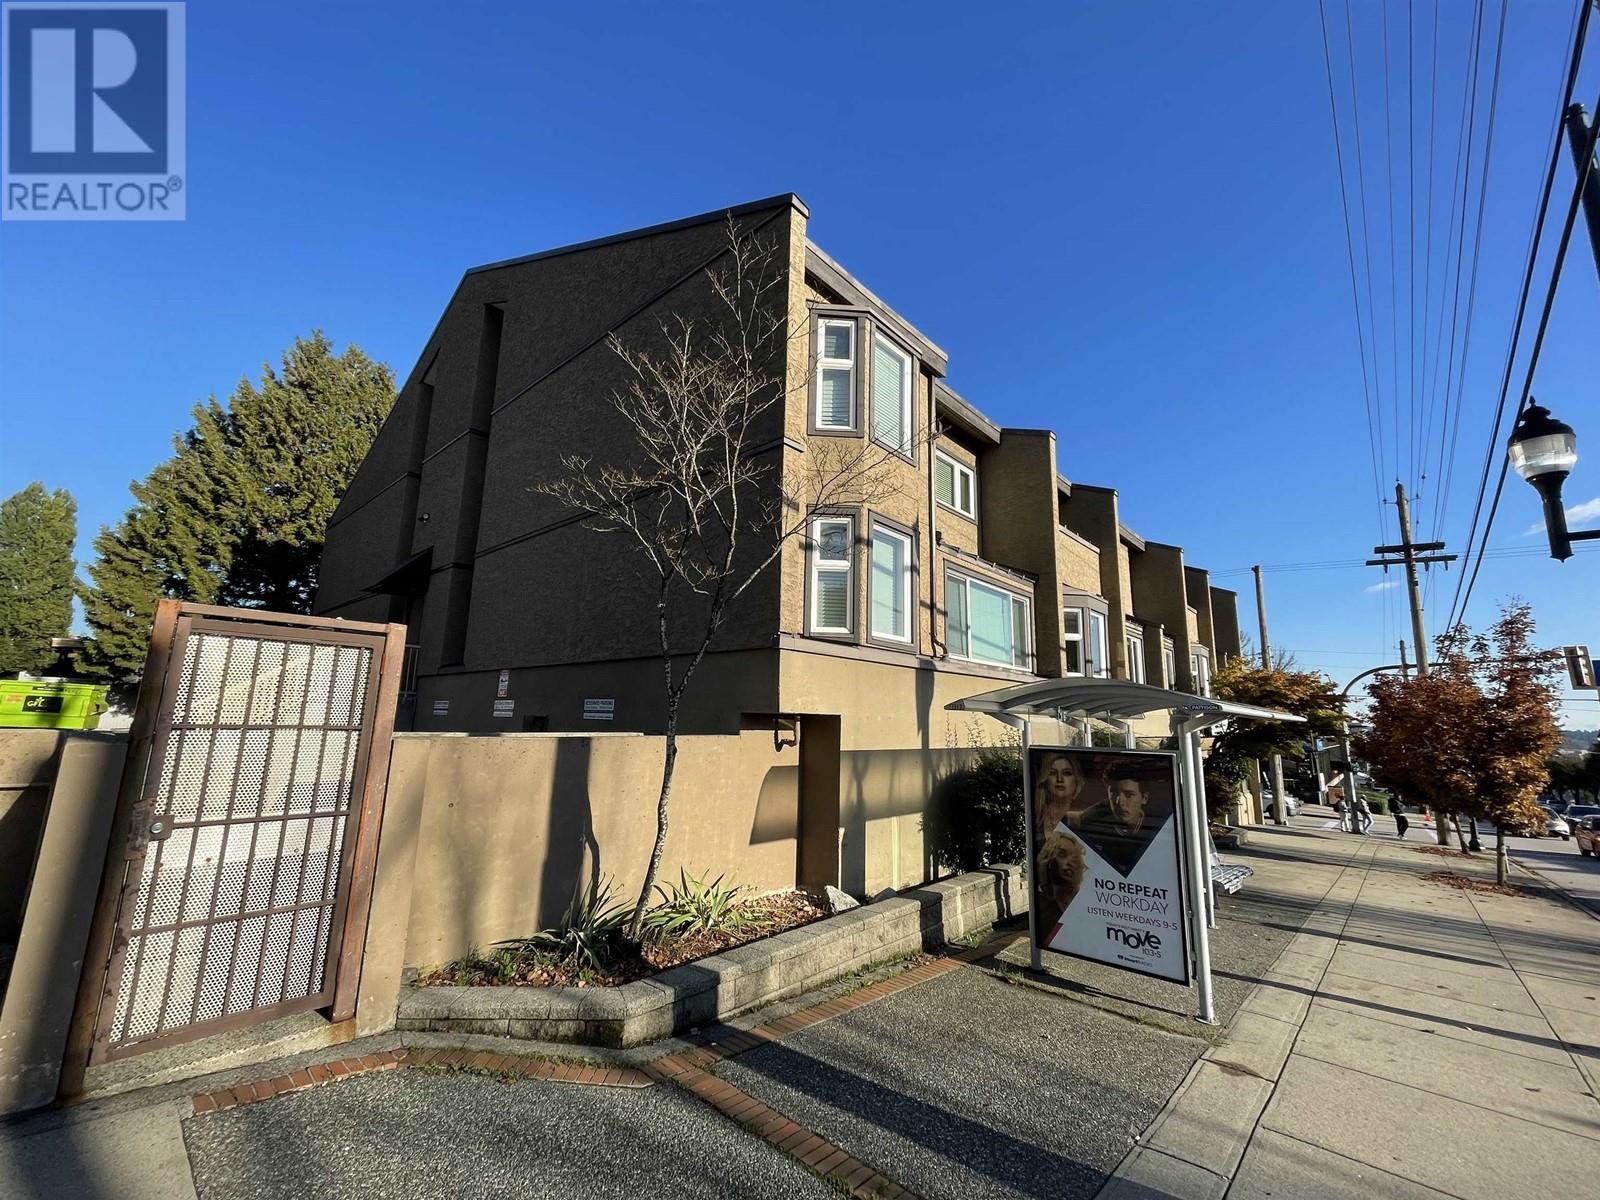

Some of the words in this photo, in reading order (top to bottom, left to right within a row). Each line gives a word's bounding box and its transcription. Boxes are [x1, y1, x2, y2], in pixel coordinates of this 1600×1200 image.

[1094, 877, 1116, 891] NO
[1118, 881, 1169, 900] REPEAT
[1095, 890, 1169, 915] WORKDAY
[1087, 906, 1114, 918] LISTEN
[1114, 910, 1162, 928] WEEKDAYS
[1162, 920, 1178, 931] 9-5
[1106, 926, 1162, 949] move
